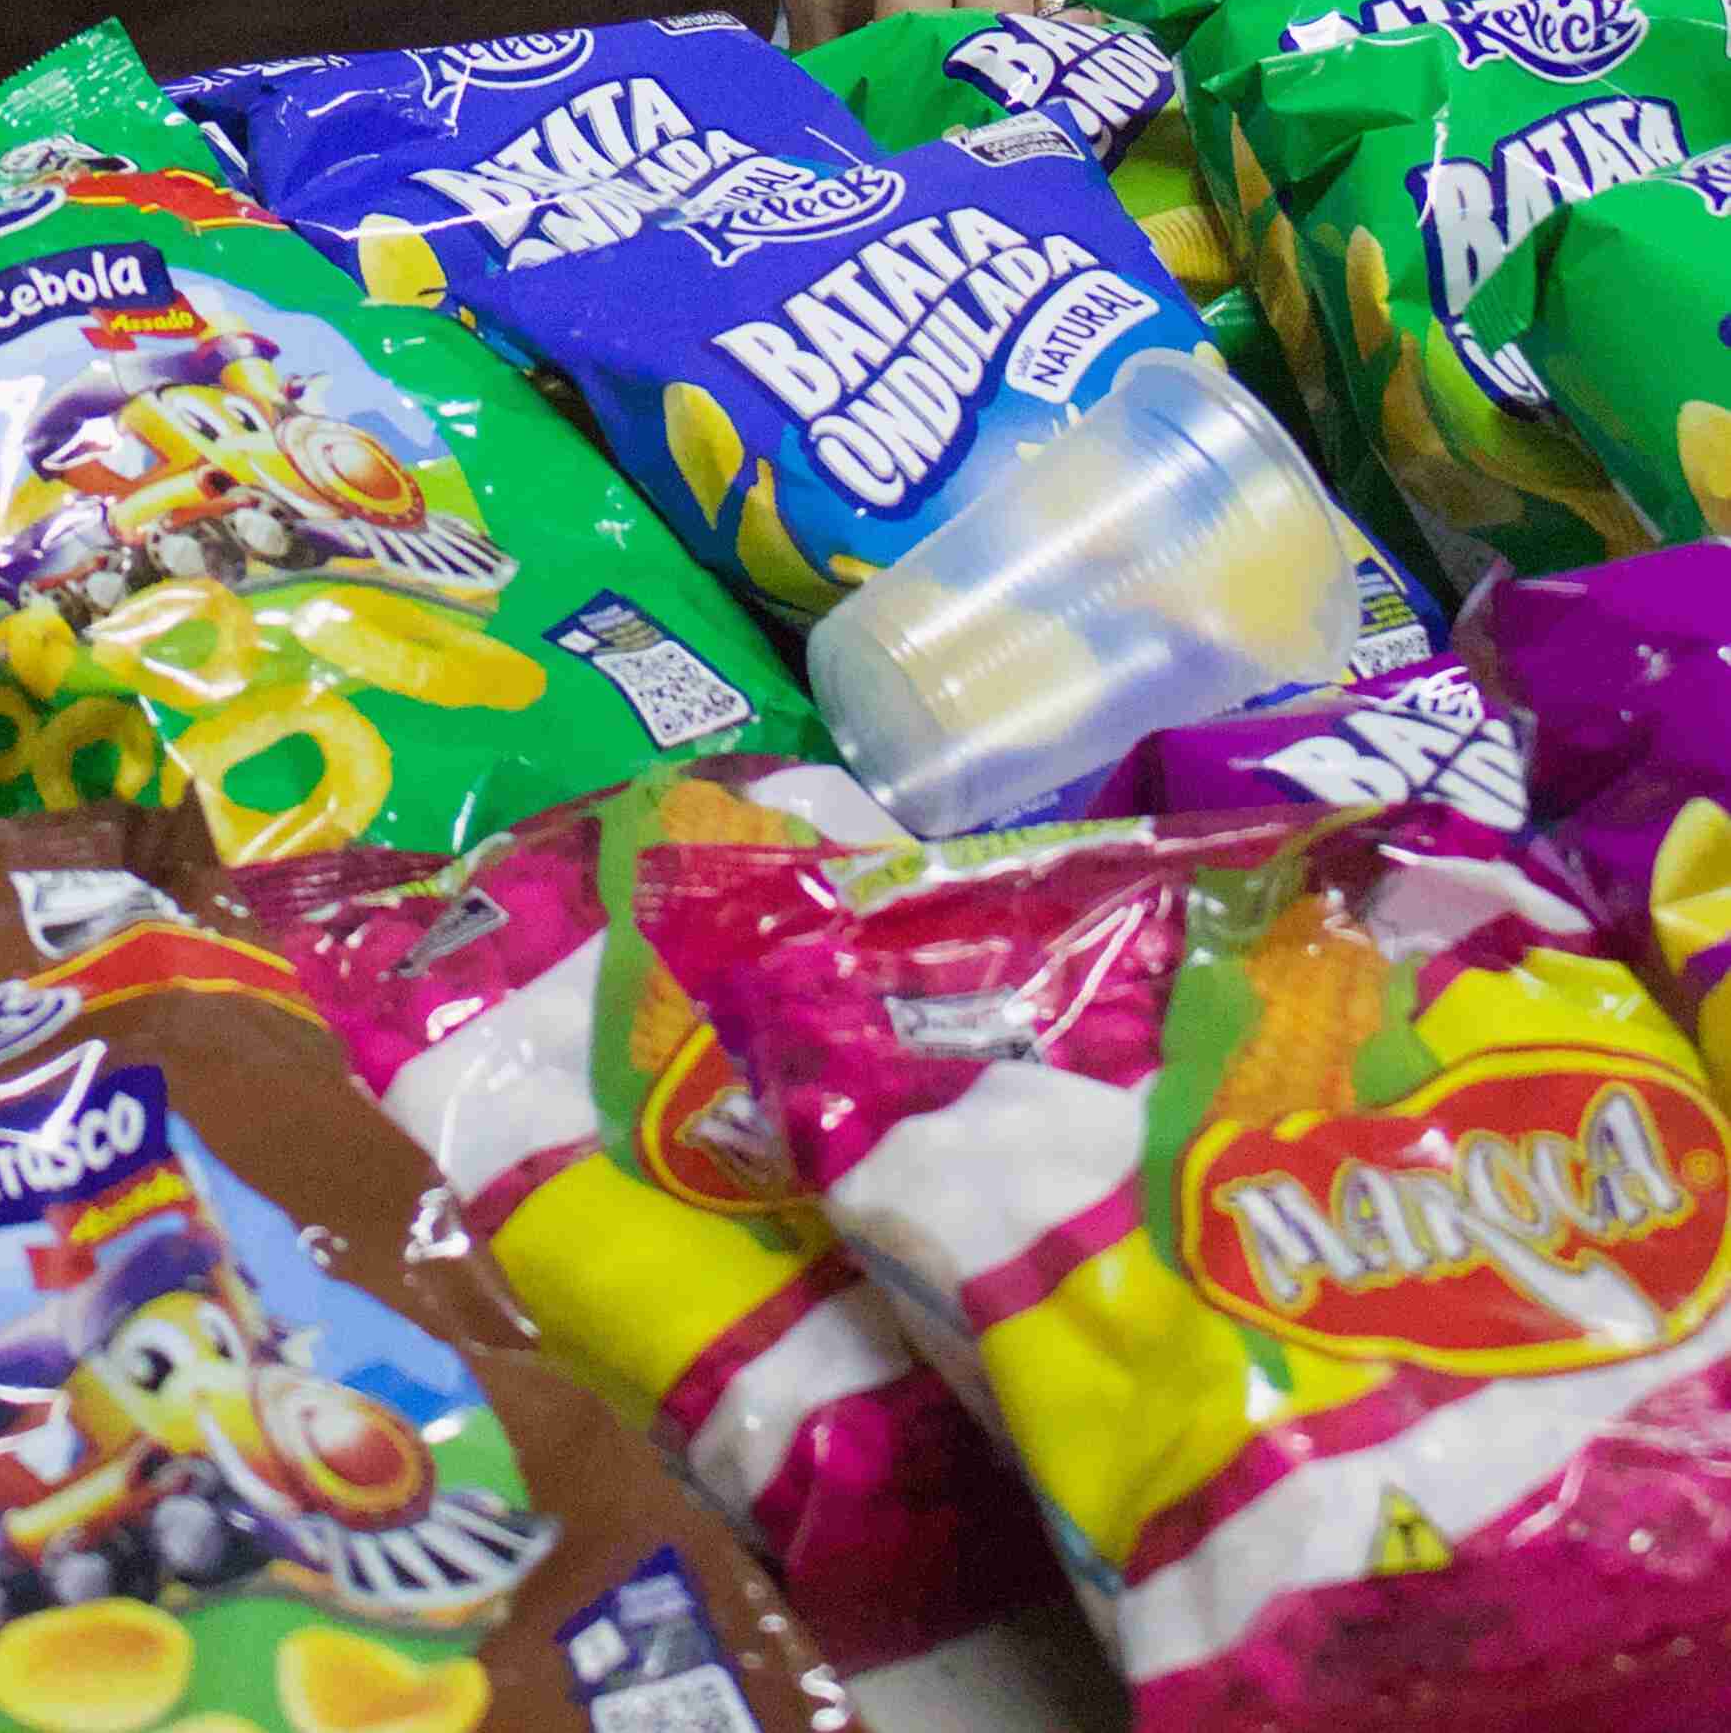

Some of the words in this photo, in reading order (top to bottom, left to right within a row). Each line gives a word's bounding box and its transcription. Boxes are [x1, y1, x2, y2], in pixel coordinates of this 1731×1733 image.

[685, 165, 906, 267] Keleck
[711, 207, 1029, 421] BATATA
[809, 235, 1099, 508] ONDULADA
[1031, 283, 1145, 388] NATURAL
